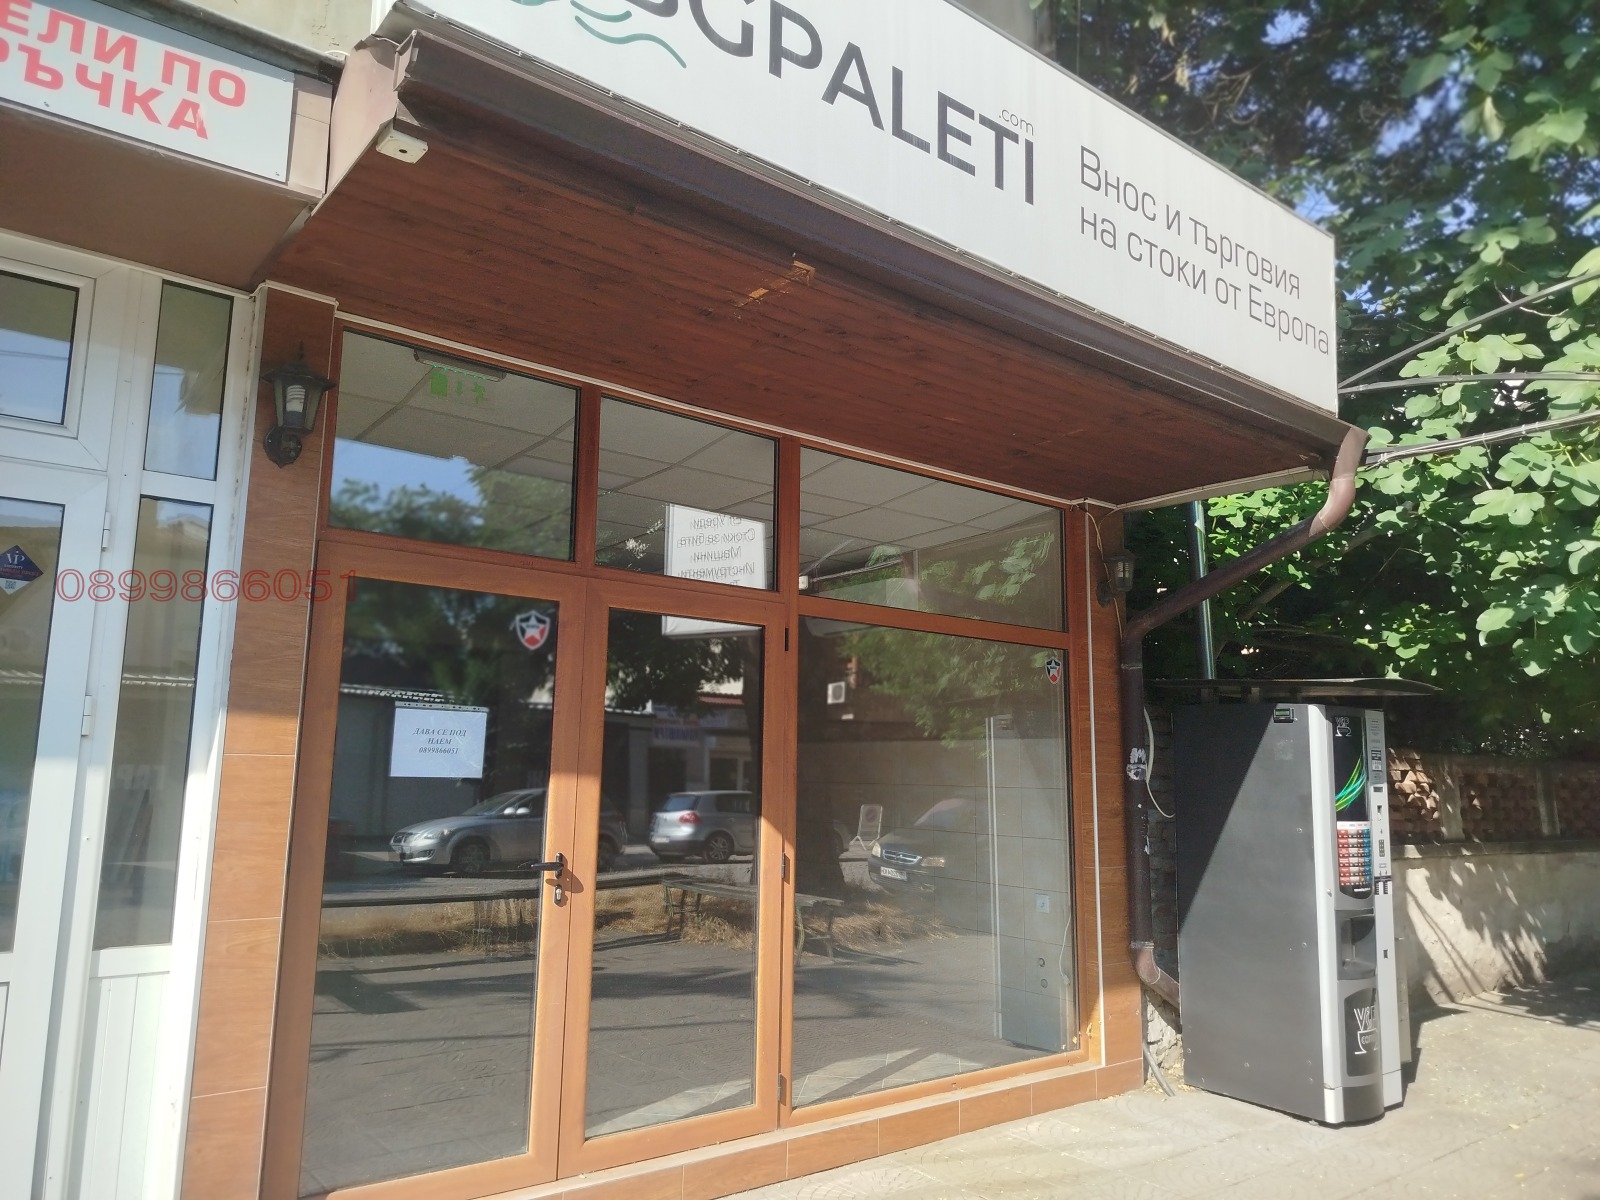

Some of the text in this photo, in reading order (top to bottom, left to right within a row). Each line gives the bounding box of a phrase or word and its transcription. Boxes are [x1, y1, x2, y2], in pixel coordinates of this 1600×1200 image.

[161, 50, 246, 107] ПО
[625, 0, 1033, 206] GPALETI
[999, 109, 1034, 136] .com
[1080, 145, 1301, 300] Внос и търговия
[1080, 206, 1330, 356] на стоки от Европа
[412, 727, 467, 737] ДАВА СЕ ПОД
